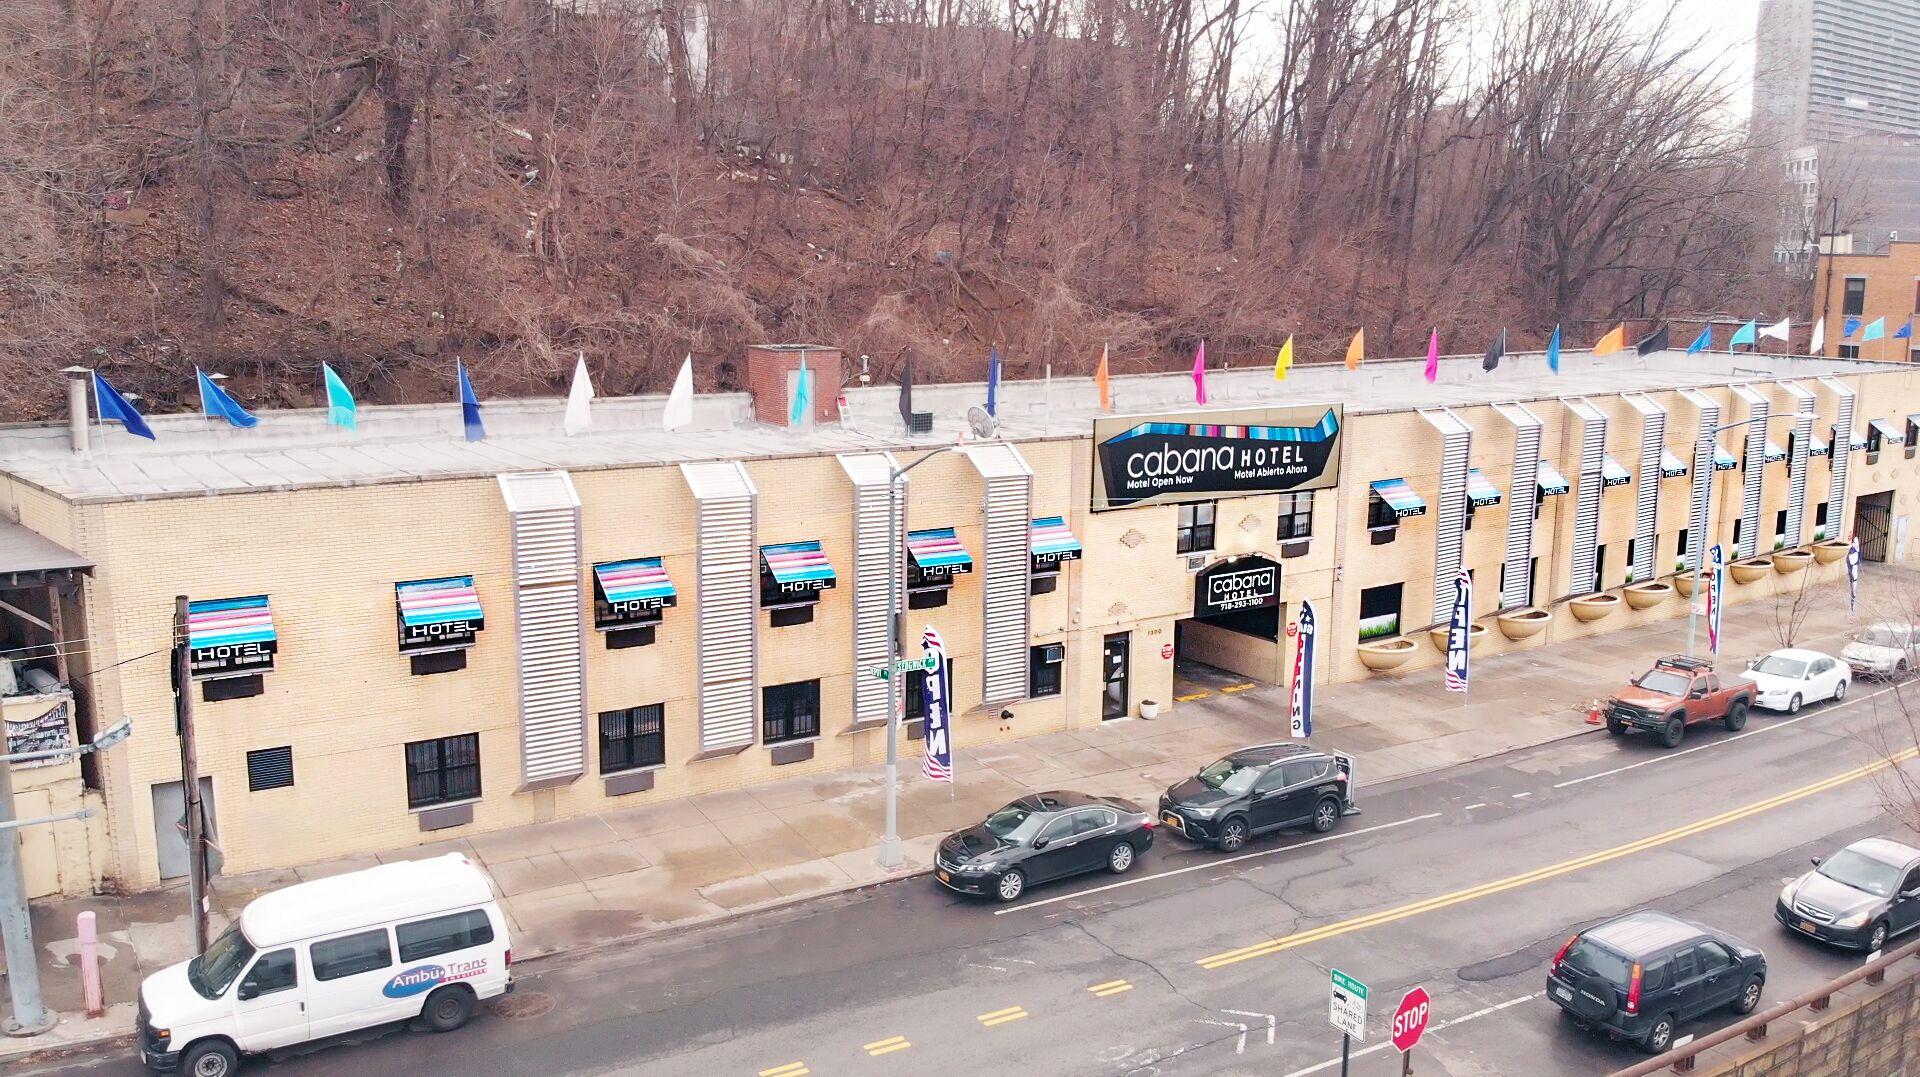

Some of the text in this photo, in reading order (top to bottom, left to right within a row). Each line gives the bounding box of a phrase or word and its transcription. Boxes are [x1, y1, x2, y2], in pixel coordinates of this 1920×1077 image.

[1127, 442, 1304, 478] cabana HOTEL
[1234, 464, 1308, 480] Motel Abierto Ahora
[1126, 475, 1194, 490] Motel Open Now
[1607, 477, 1628, 486] HOTEL
[1543, 485, 1567, 496] HOTEL
[1472, 496, 1498, 507] HOTEL
[1395, 506, 1423, 518] HOTEL
[1036, 551, 1078, 564] HOTEL
[923, 563, 969, 577] HOTEL
[781, 579, 832, 594] HOTEL
[1213, 572, 1271, 594] cabana
[1223, 588, 1259, 601] HOTEL
[613, 596, 672, 614] HOTEL
[1220, 597, 1264, 611] 718-293-1100
[411, 620, 478, 638] HOTEL
[197, 642, 271, 661] HOTEL
[897, 659, 927, 671] SEDGWICK
[447, 957, 488, 975] Trans
[1347, 980, 1366, 997] ROUTE
[1580, 989, 1606, 1006] HONDA
[1332, 1001, 1363, 1025] SHARED
[1393, 1001, 1428, 1038] STOP
[1337, 1016, 1358, 1033] LANE
